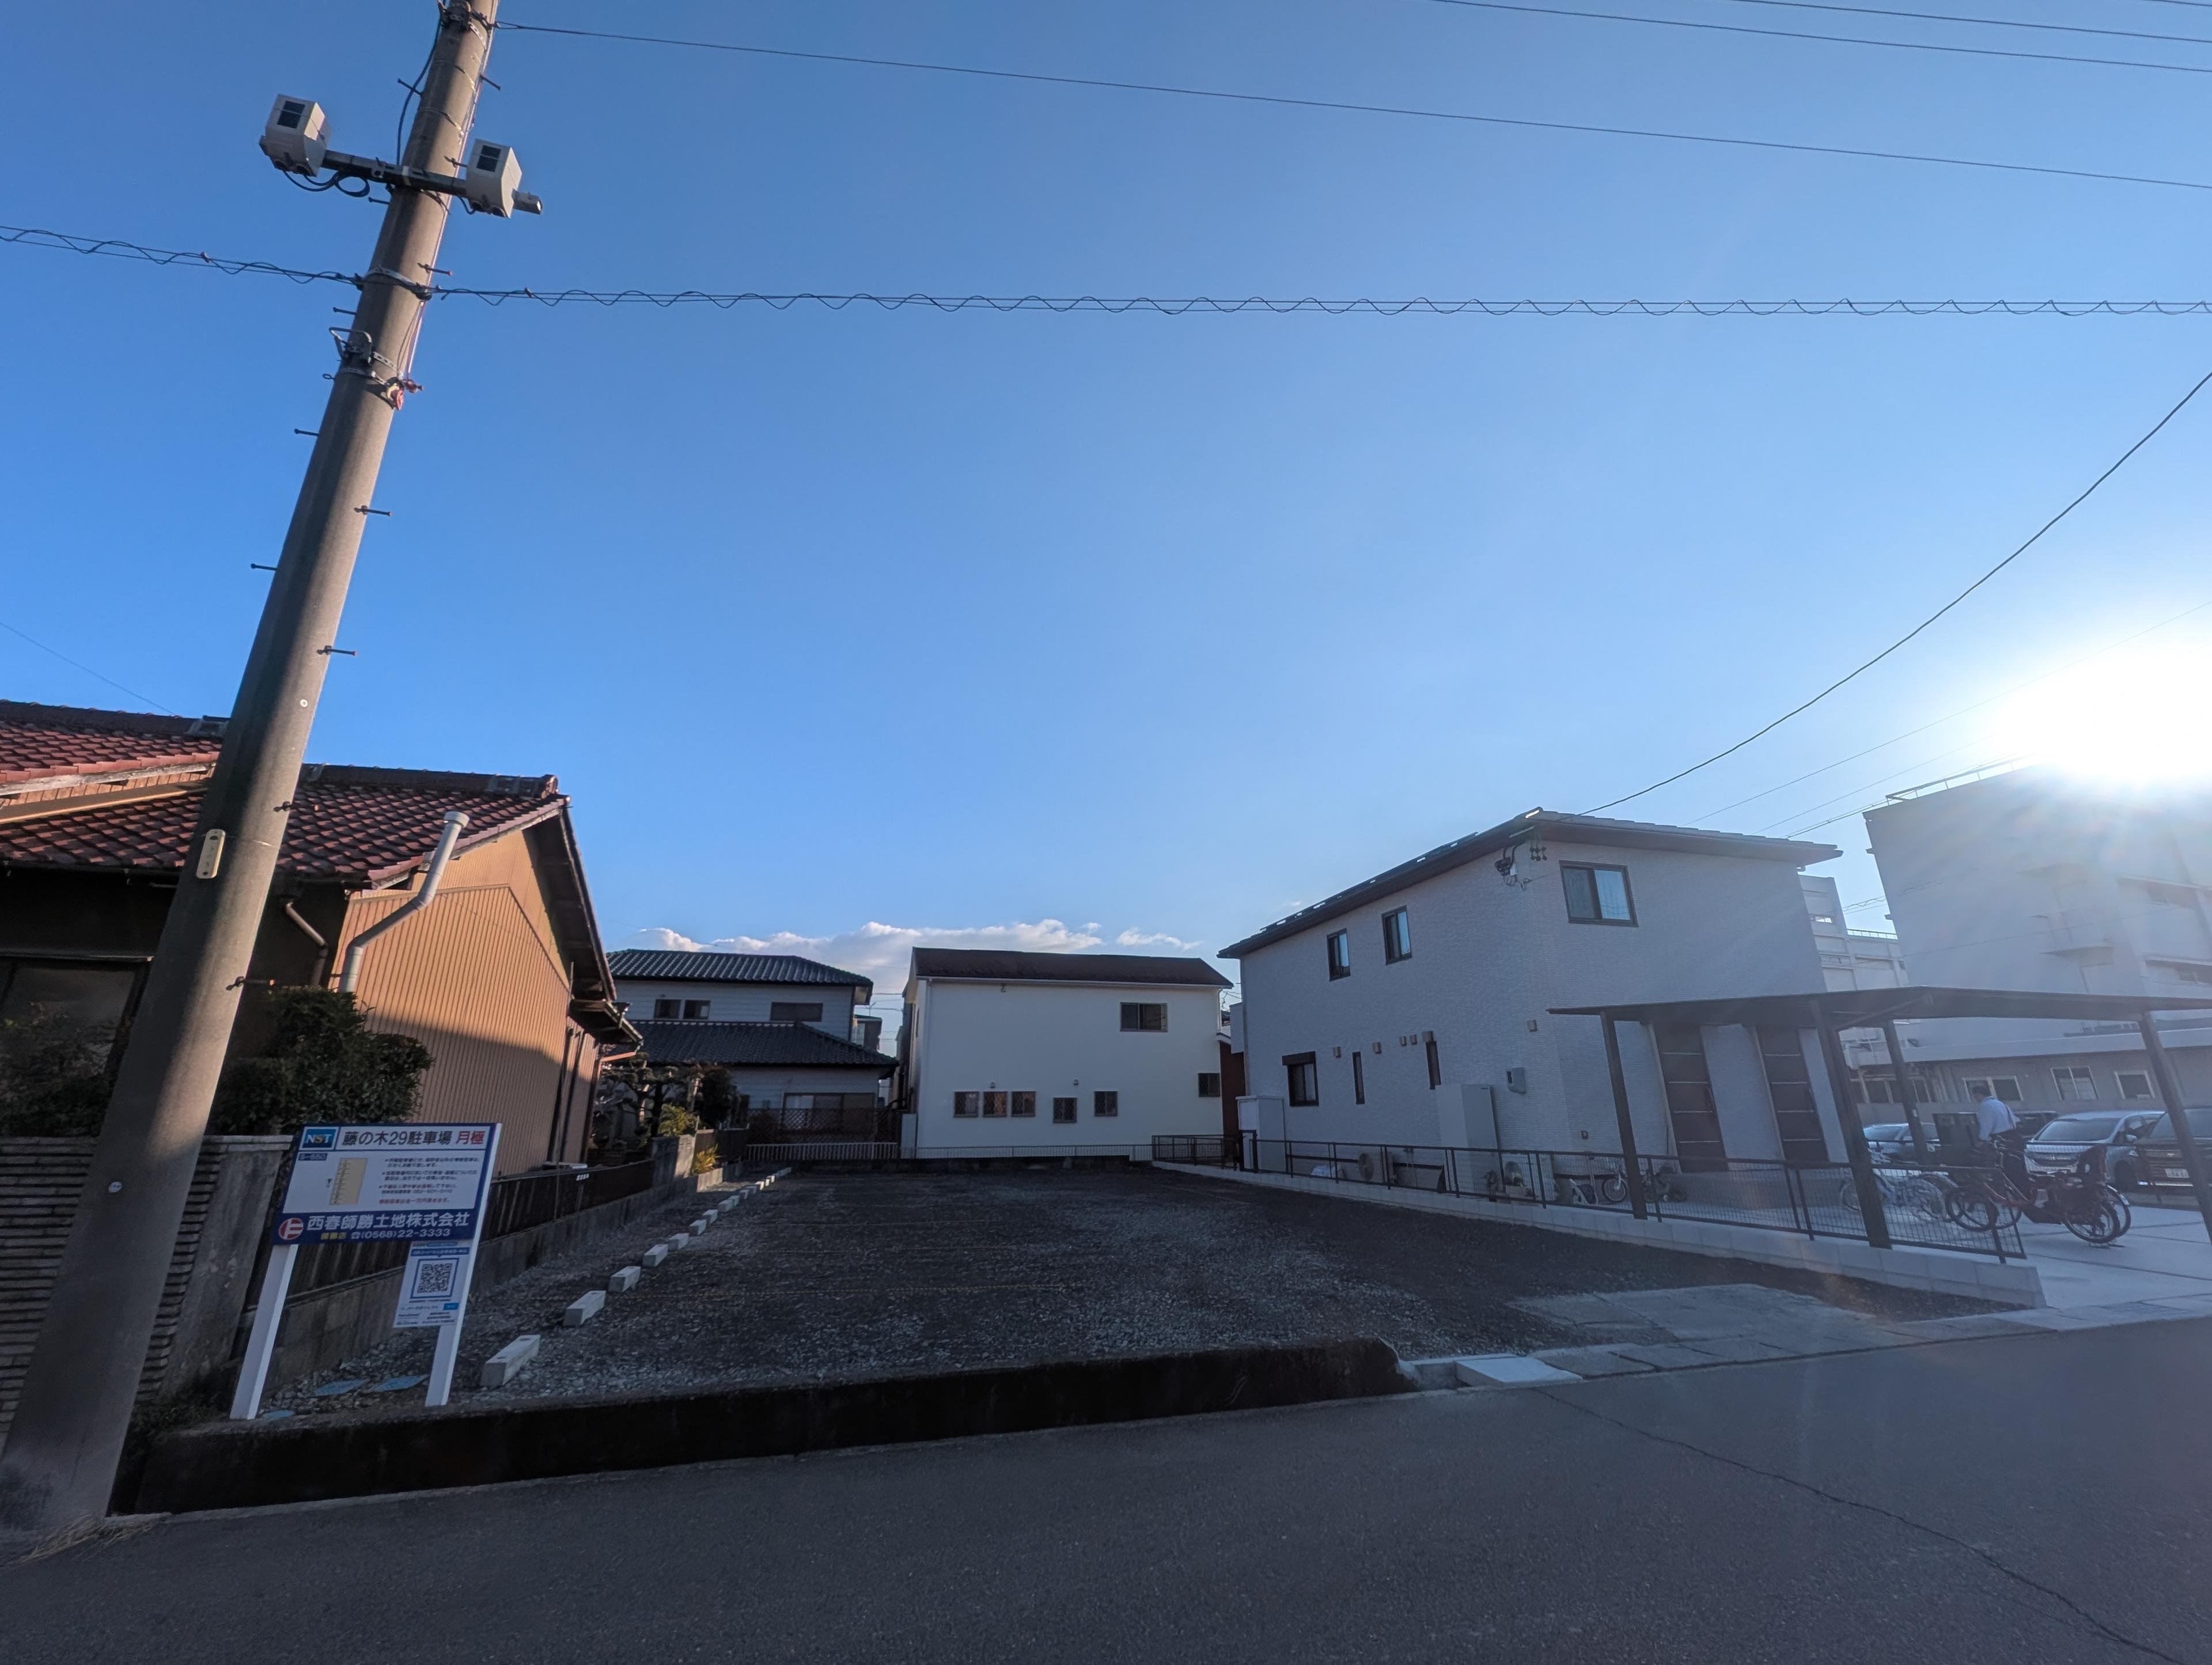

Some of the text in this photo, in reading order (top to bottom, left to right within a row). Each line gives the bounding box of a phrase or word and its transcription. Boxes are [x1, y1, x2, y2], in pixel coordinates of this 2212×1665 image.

[306, 1134, 332, 1143] NST
[342, 1130, 486, 1146] 藤の木29駐車場 月極
[307, 1212, 471, 1231] 西春師勝土地株式会社
